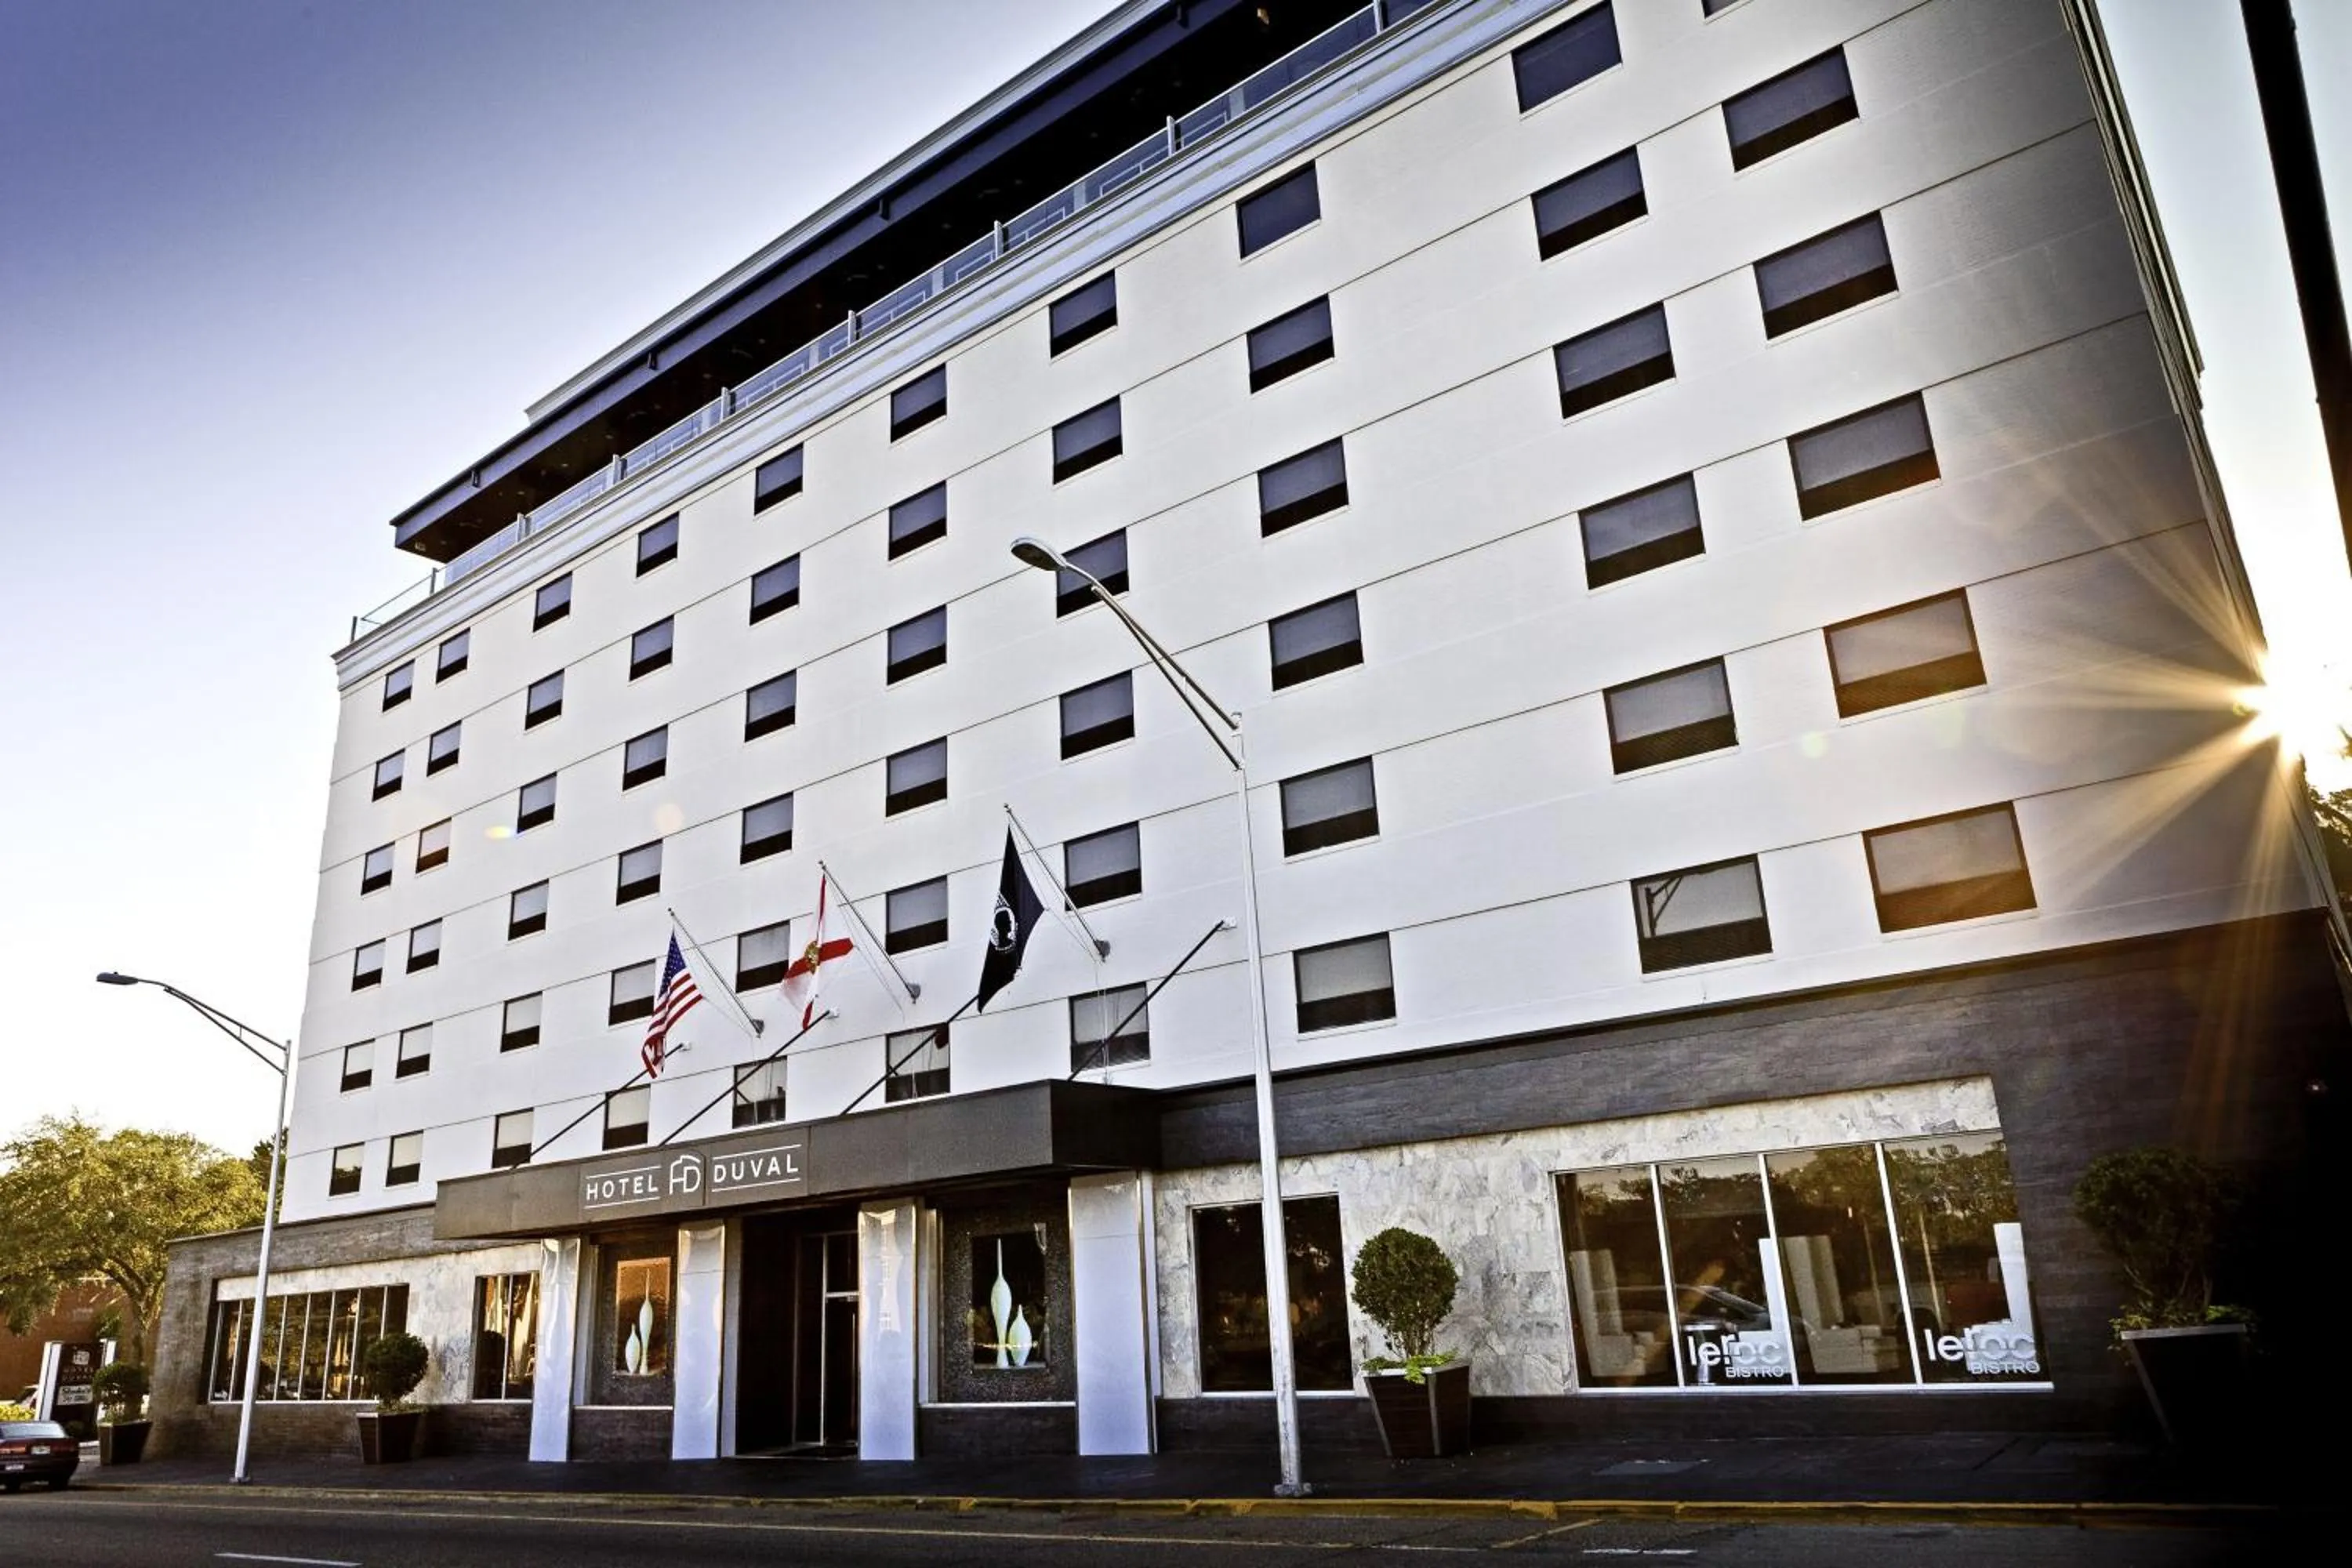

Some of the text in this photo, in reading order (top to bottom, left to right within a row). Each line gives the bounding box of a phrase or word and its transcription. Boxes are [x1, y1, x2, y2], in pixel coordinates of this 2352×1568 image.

[586, 1174, 659, 1200] HOTEL
[713, 1153, 799, 1183] DUVAL
[1725, 1365, 1784, 1377] BISTRO
[1970, 1360, 2041, 1374] BISTRO
